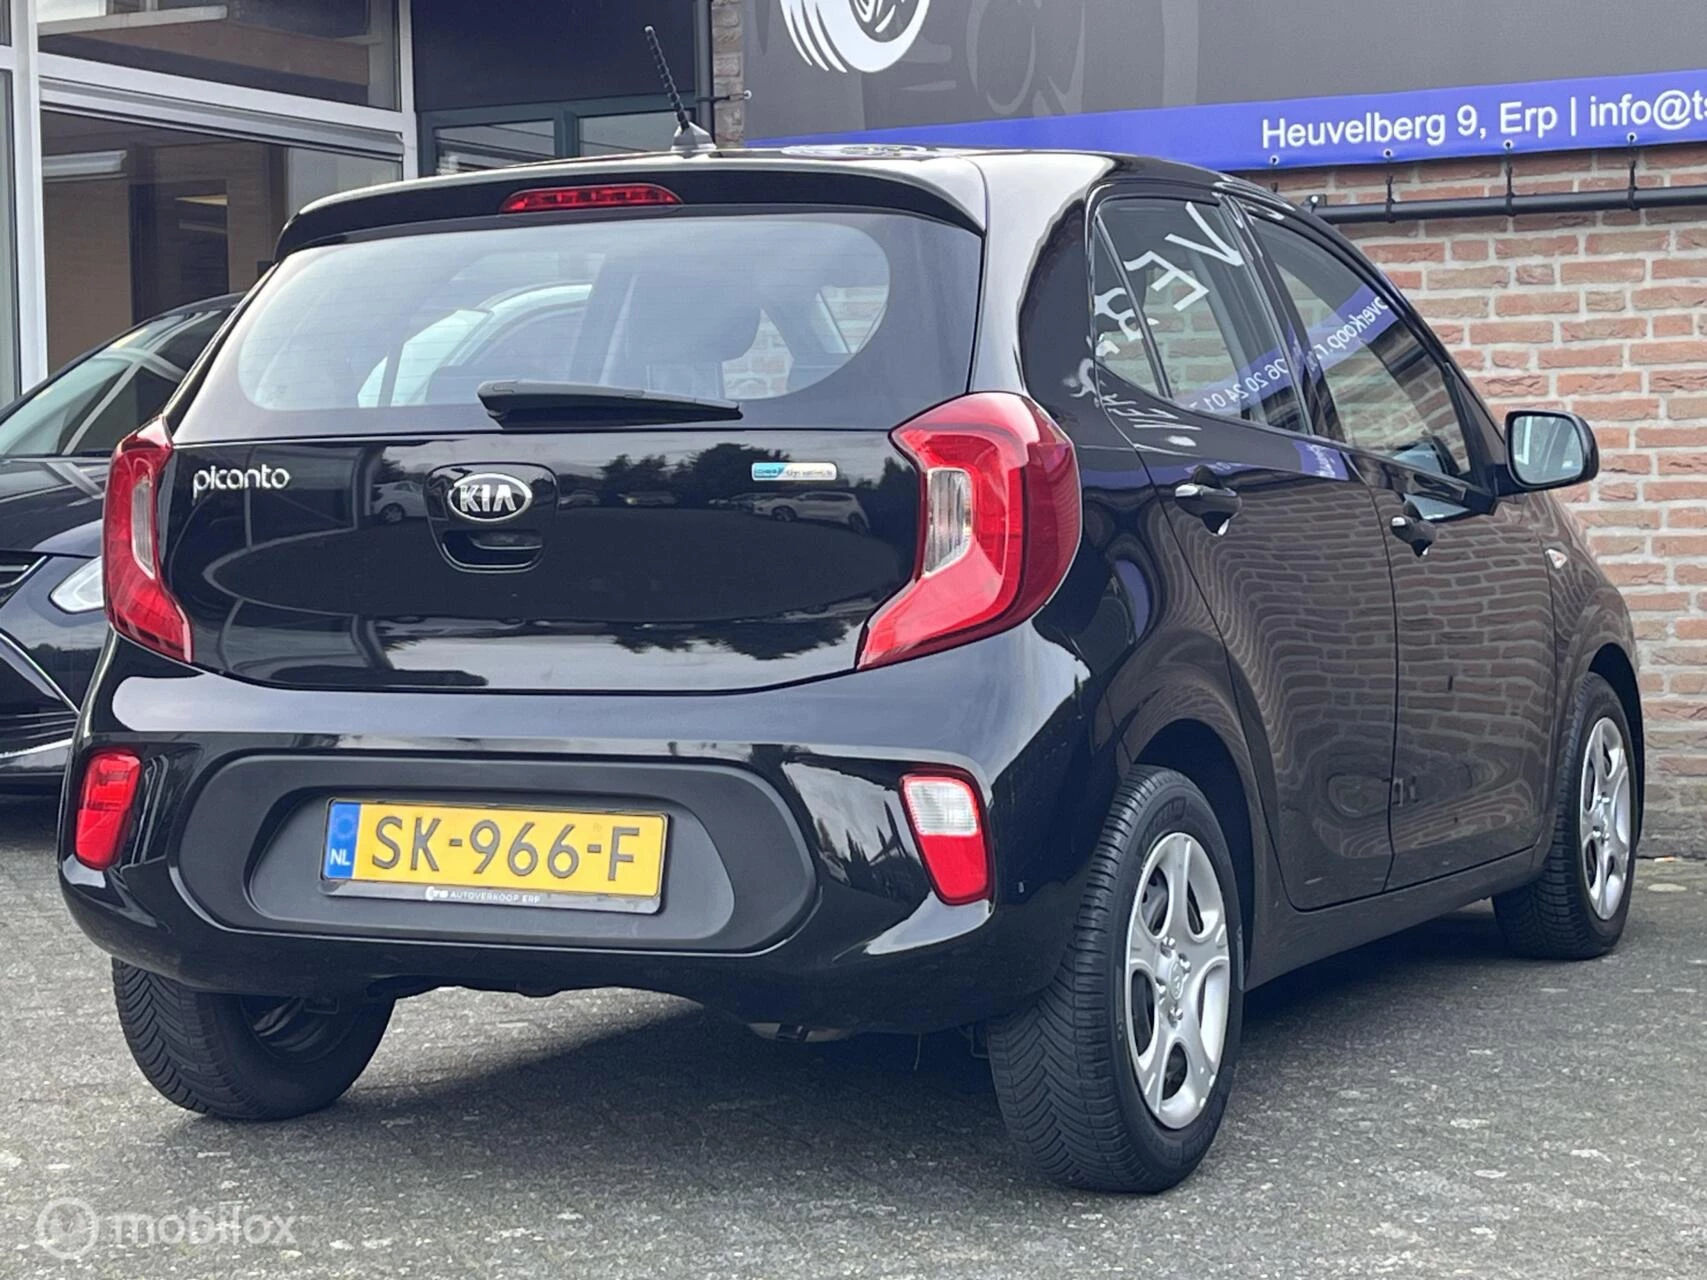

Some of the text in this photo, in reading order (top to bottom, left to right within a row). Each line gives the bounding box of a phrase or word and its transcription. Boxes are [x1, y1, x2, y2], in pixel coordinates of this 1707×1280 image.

[1262, 111, 1446, 149] Heuvelberg
[1457, 104, 1487, 140] 9,
[1499, 100, 1558, 139] Erp
[1589, 89, 1707, 131] info@t
[192, 464, 290, 501] picanto
[460, 484, 517, 512] KIA
[330, 847, 351, 867] NL
[371, 815, 640, 882] SK-966-F
[450, 890, 518, 902] AUTOVERKOOP
[522, 894, 541, 904] ERP
